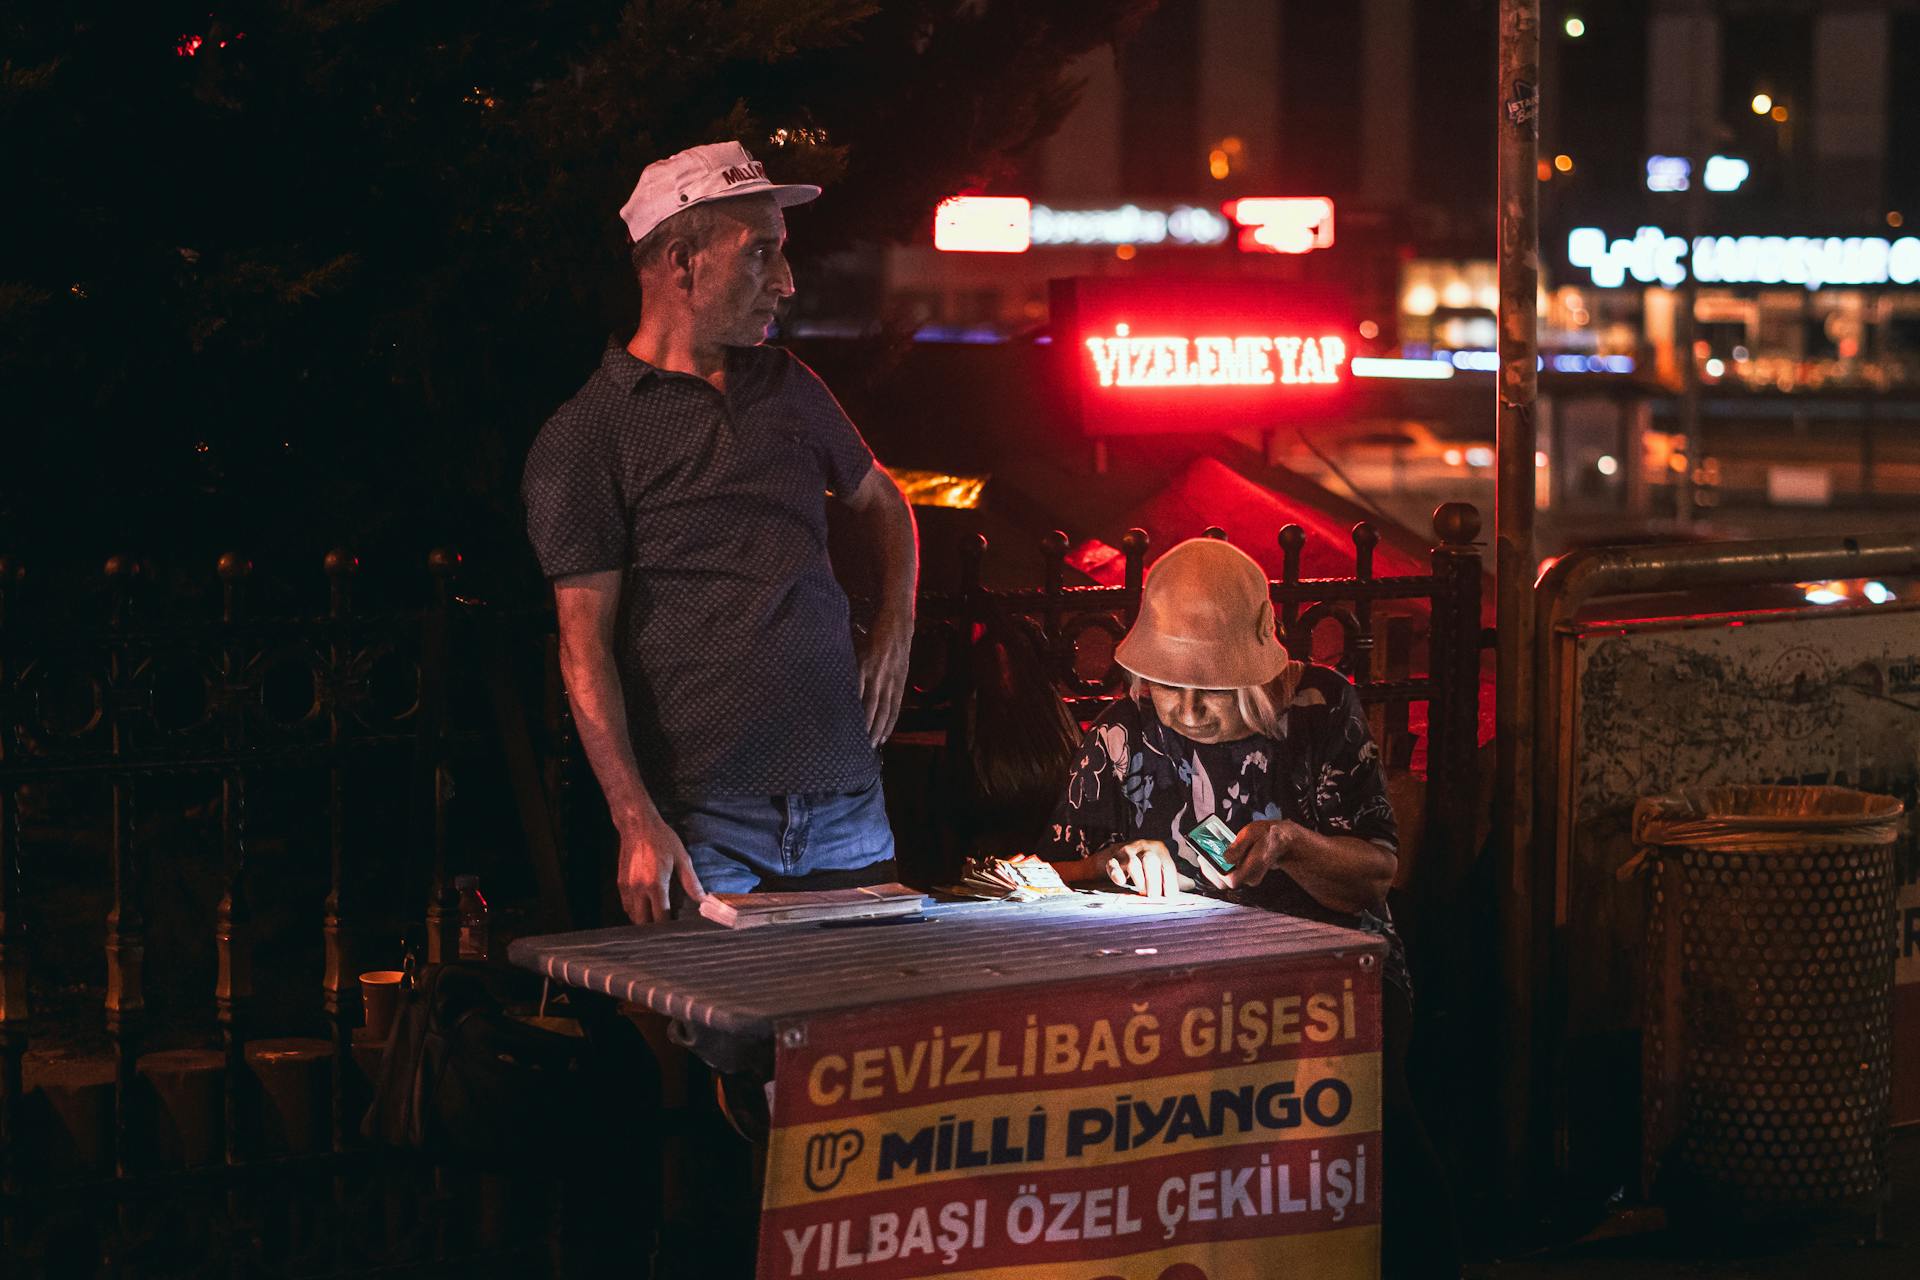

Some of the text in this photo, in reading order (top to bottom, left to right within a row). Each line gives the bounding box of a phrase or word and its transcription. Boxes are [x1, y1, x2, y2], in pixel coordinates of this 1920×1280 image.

[1086, 323, 1345, 386] VİZELEME YAP
[807, 979, 1356, 1106] CEVİZLİBAĞ GİŞESİ
[1066, 1078, 1352, 1157] PİYANGO
[783, 1144, 1366, 1276] YILBAŞI ÖZEL ÇEKİLİŞİ
